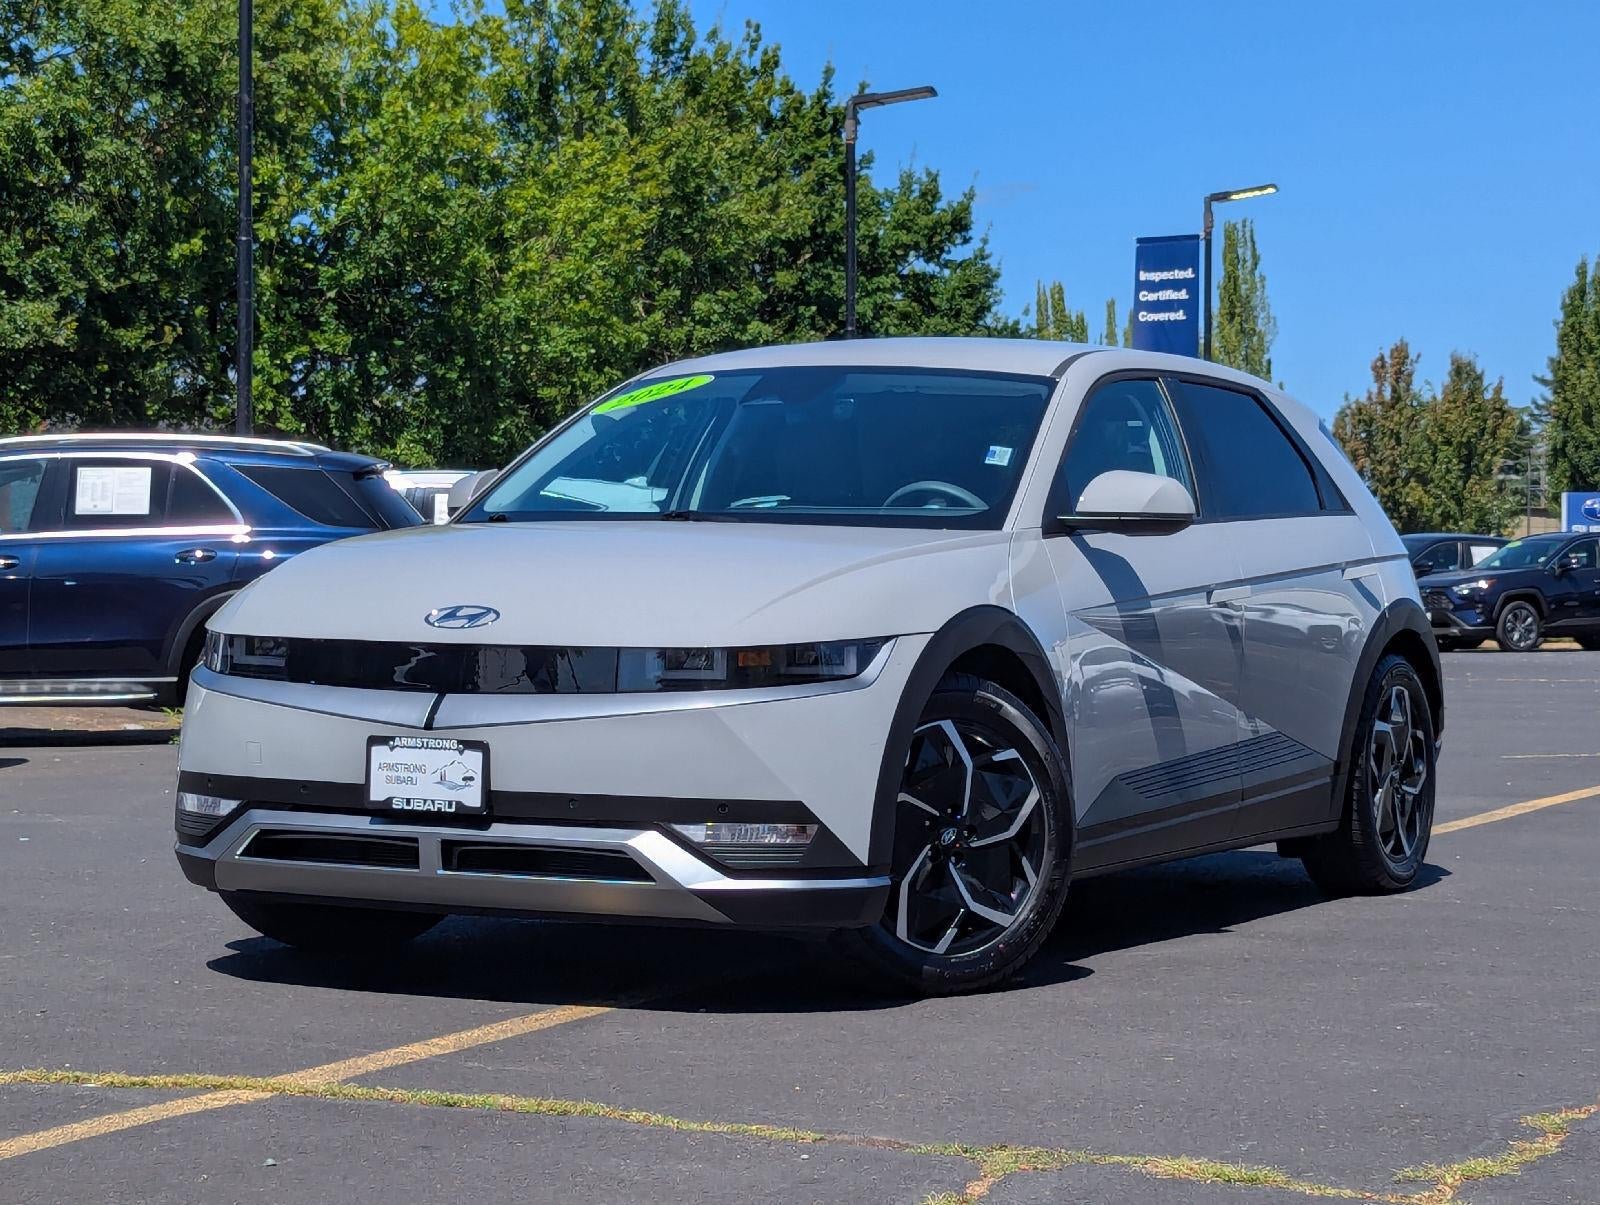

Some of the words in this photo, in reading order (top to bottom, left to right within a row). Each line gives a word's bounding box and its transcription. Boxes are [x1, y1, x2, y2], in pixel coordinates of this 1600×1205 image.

[1139, 268, 1195, 282] Inspected.
[1139, 289, 1189, 301] Certified.
[1138, 310, 1187, 321] Covered.
[394, 737, 458, 750] ARMSTRONG
[377, 762, 427, 774] ARMSTRONG
[385, 775, 418, 786] SUBARU
[392, 798, 456, 813] SUBARU
